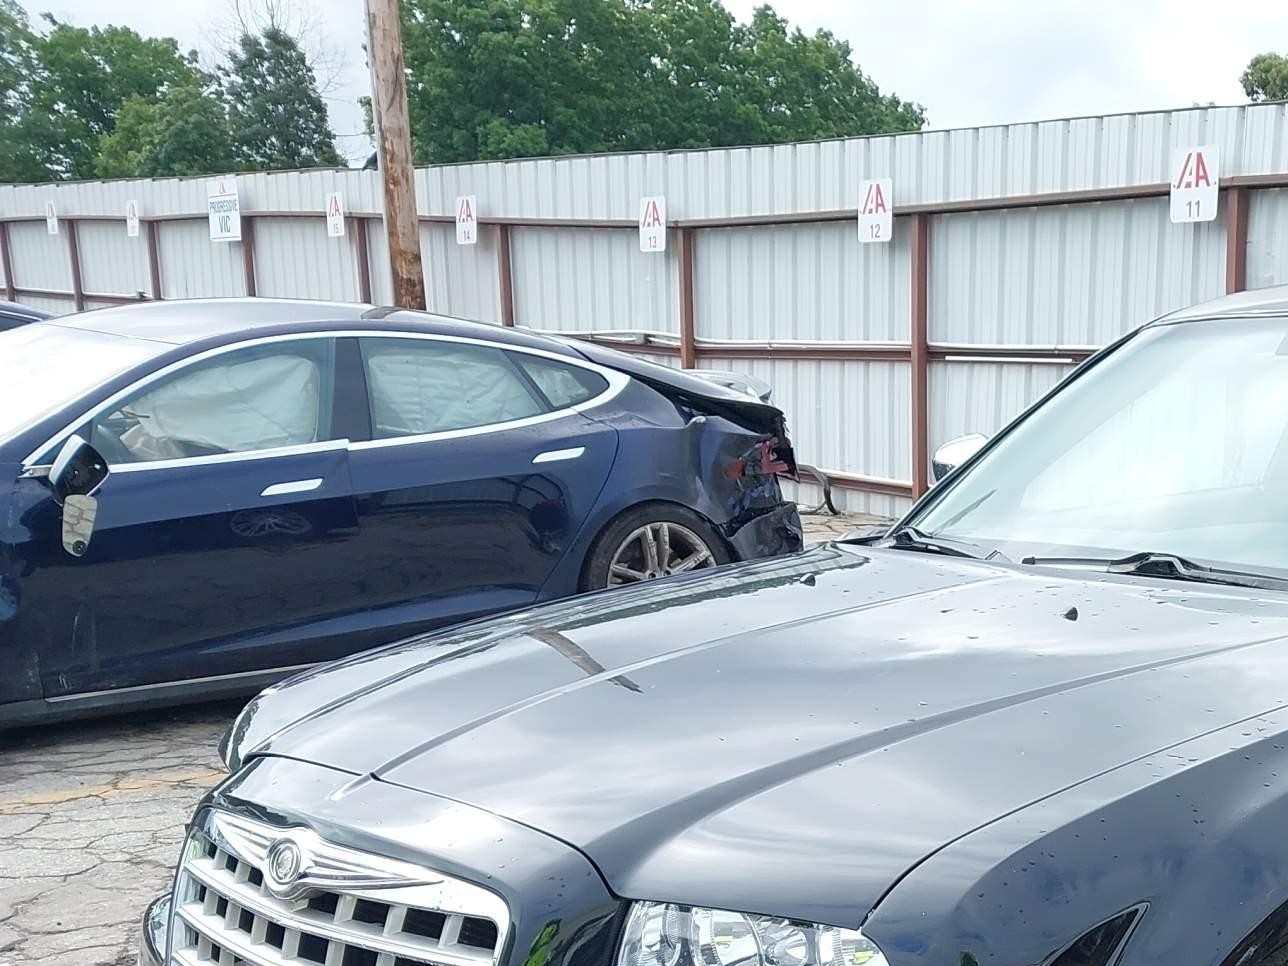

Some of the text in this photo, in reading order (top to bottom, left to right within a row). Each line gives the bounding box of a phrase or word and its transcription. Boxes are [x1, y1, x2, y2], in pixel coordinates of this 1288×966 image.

[1185, 200, 1200, 217] 11
[218, 215, 231, 233] VIC
[869, 223, 881, 238] 12
[648, 235, 657, 249] 13
